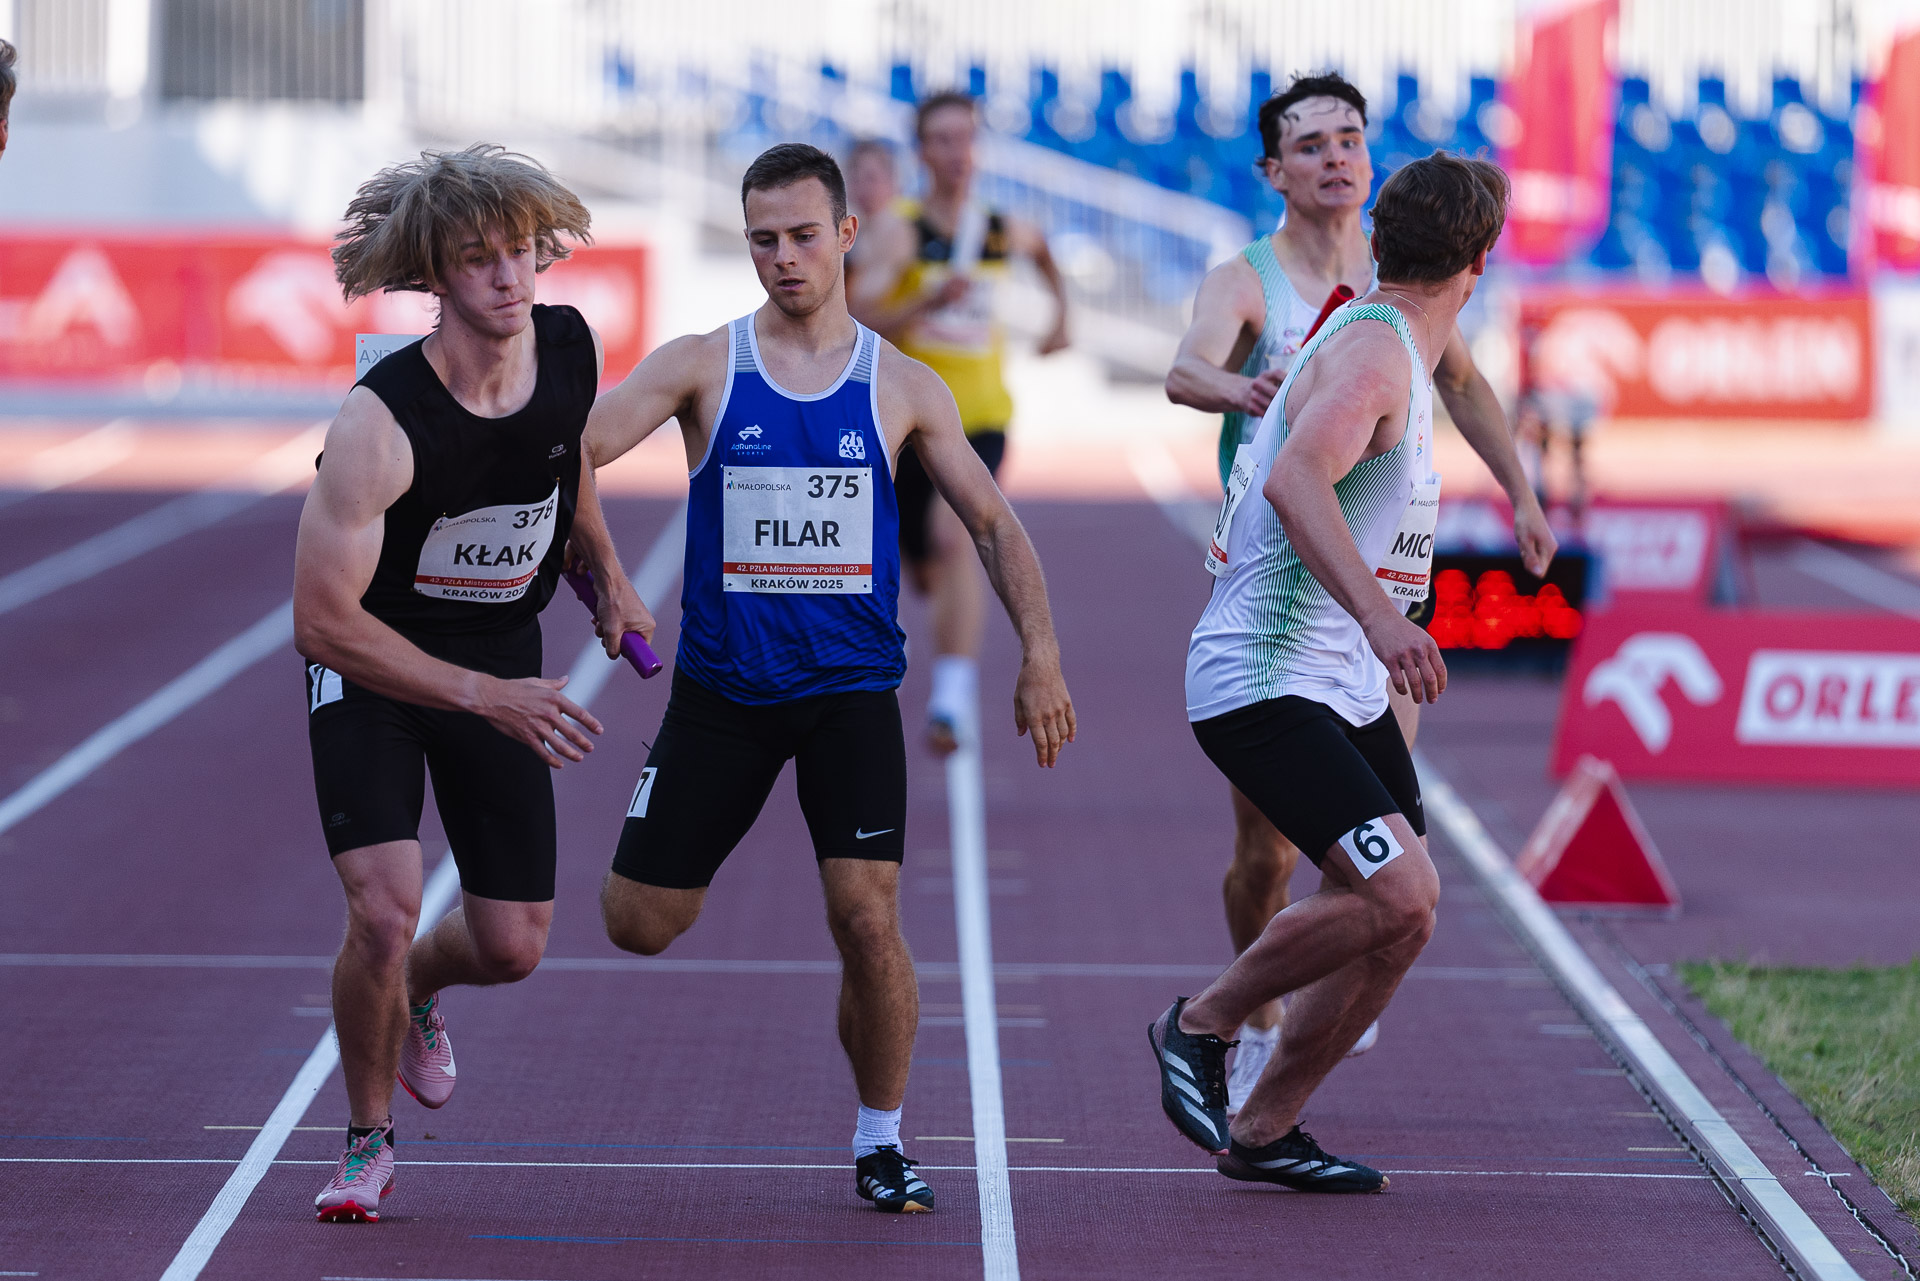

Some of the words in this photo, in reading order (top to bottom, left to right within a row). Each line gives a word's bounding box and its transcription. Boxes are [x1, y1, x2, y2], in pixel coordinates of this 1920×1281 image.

[738, 483, 792, 492] MAŁOPOLSKA
[807, 474, 860, 499] 375
[512, 499, 555, 530] 378
[755, 519, 841, 548] FILAR
[453, 540, 537, 567] KŁAK
[736, 564, 749, 573] 42.
[749, 565, 768, 573] PZLA
[769, 565, 818, 574] Mistrzostwa
[819, 565, 843, 574] Polski
[844, 566, 860, 574] U23
[442, 587, 502, 599] KRAKÓW
[443, 578, 462, 586] PZLA
[463, 579, 512, 588] Mistrzostwa
[751, 576, 810, 589] KRAKÓW
[814, 579, 844, 589] 2025
[630, 771, 650, 813] 7
[1353, 823, 1390, 864] 6
